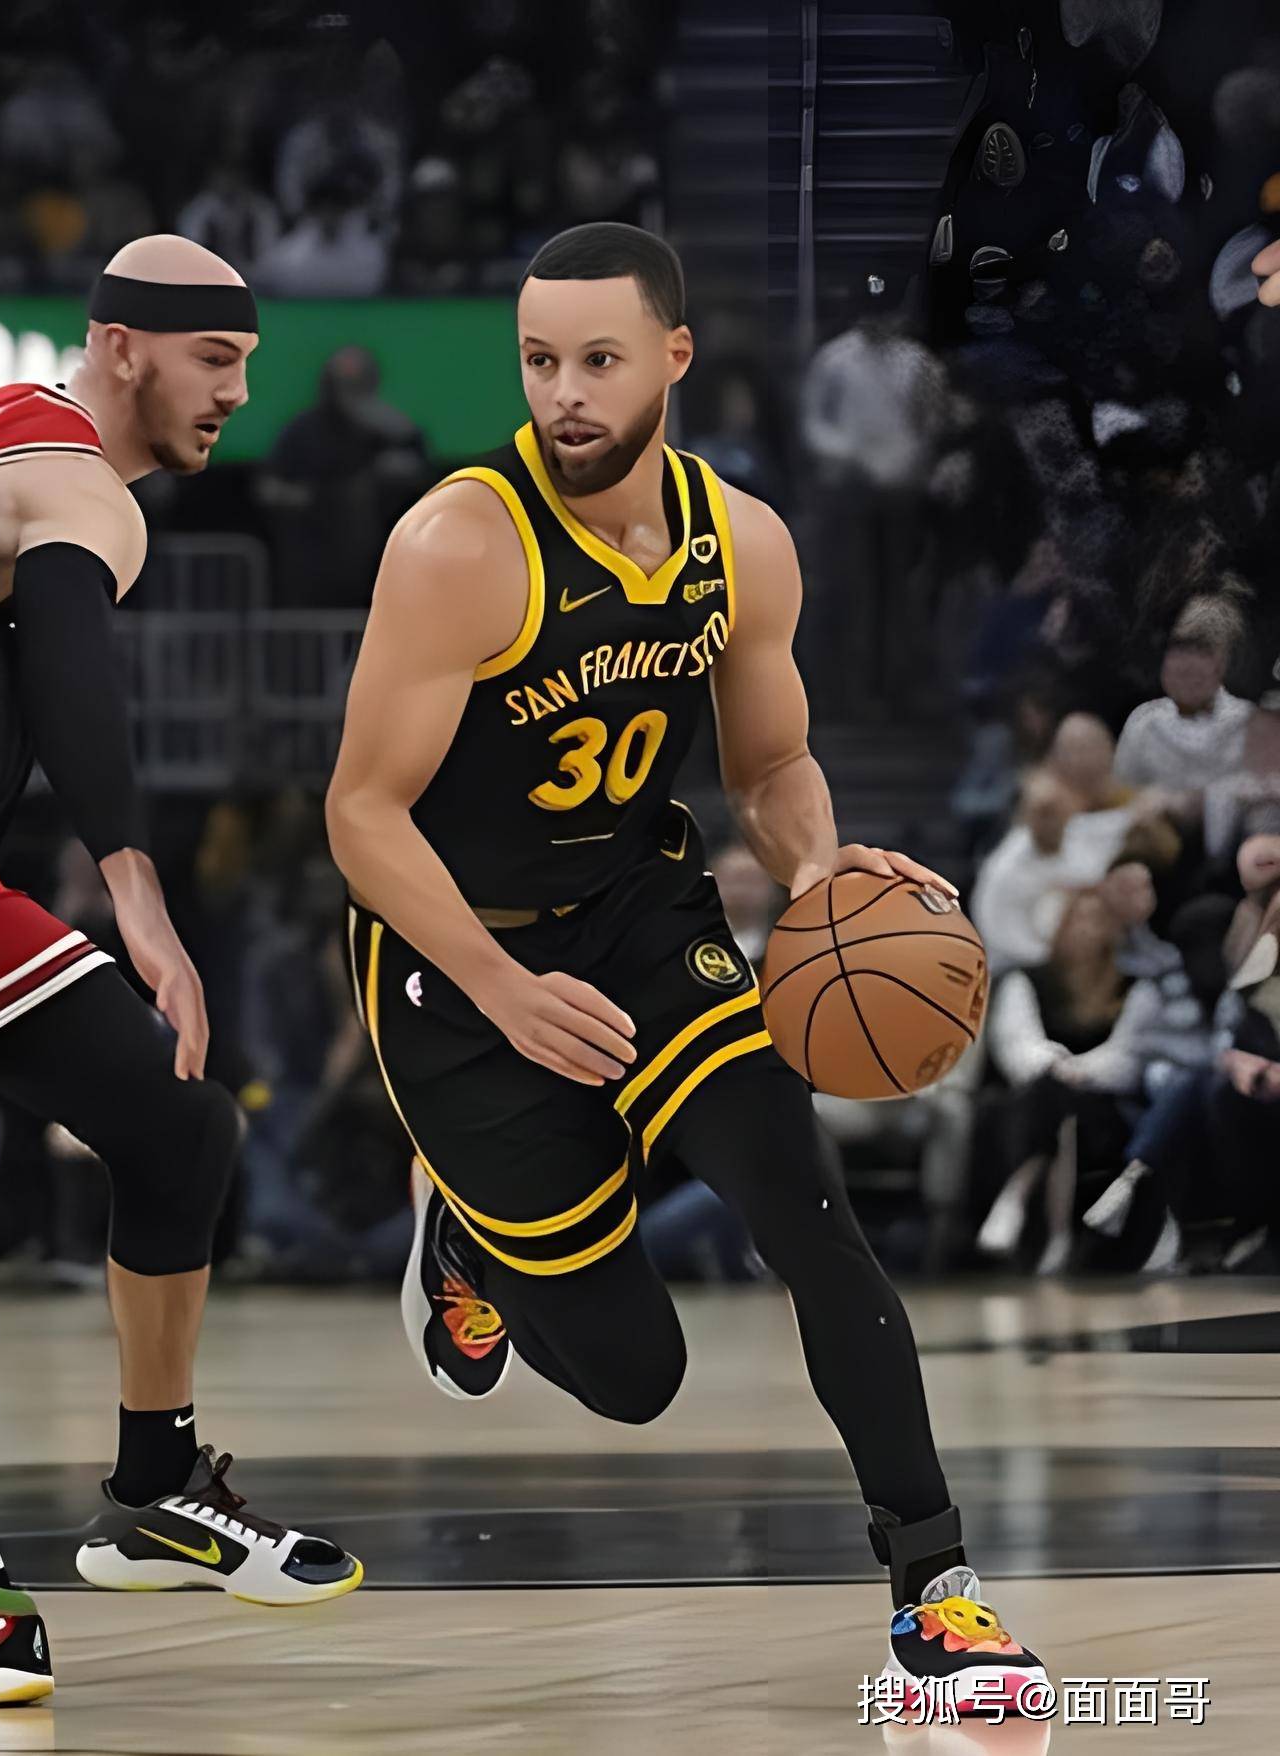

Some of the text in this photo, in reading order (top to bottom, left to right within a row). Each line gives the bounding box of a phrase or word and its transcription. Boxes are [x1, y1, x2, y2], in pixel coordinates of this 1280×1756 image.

[504, 610, 730, 726] SAN FRANCISCO
[527, 708, 669, 812] 30
